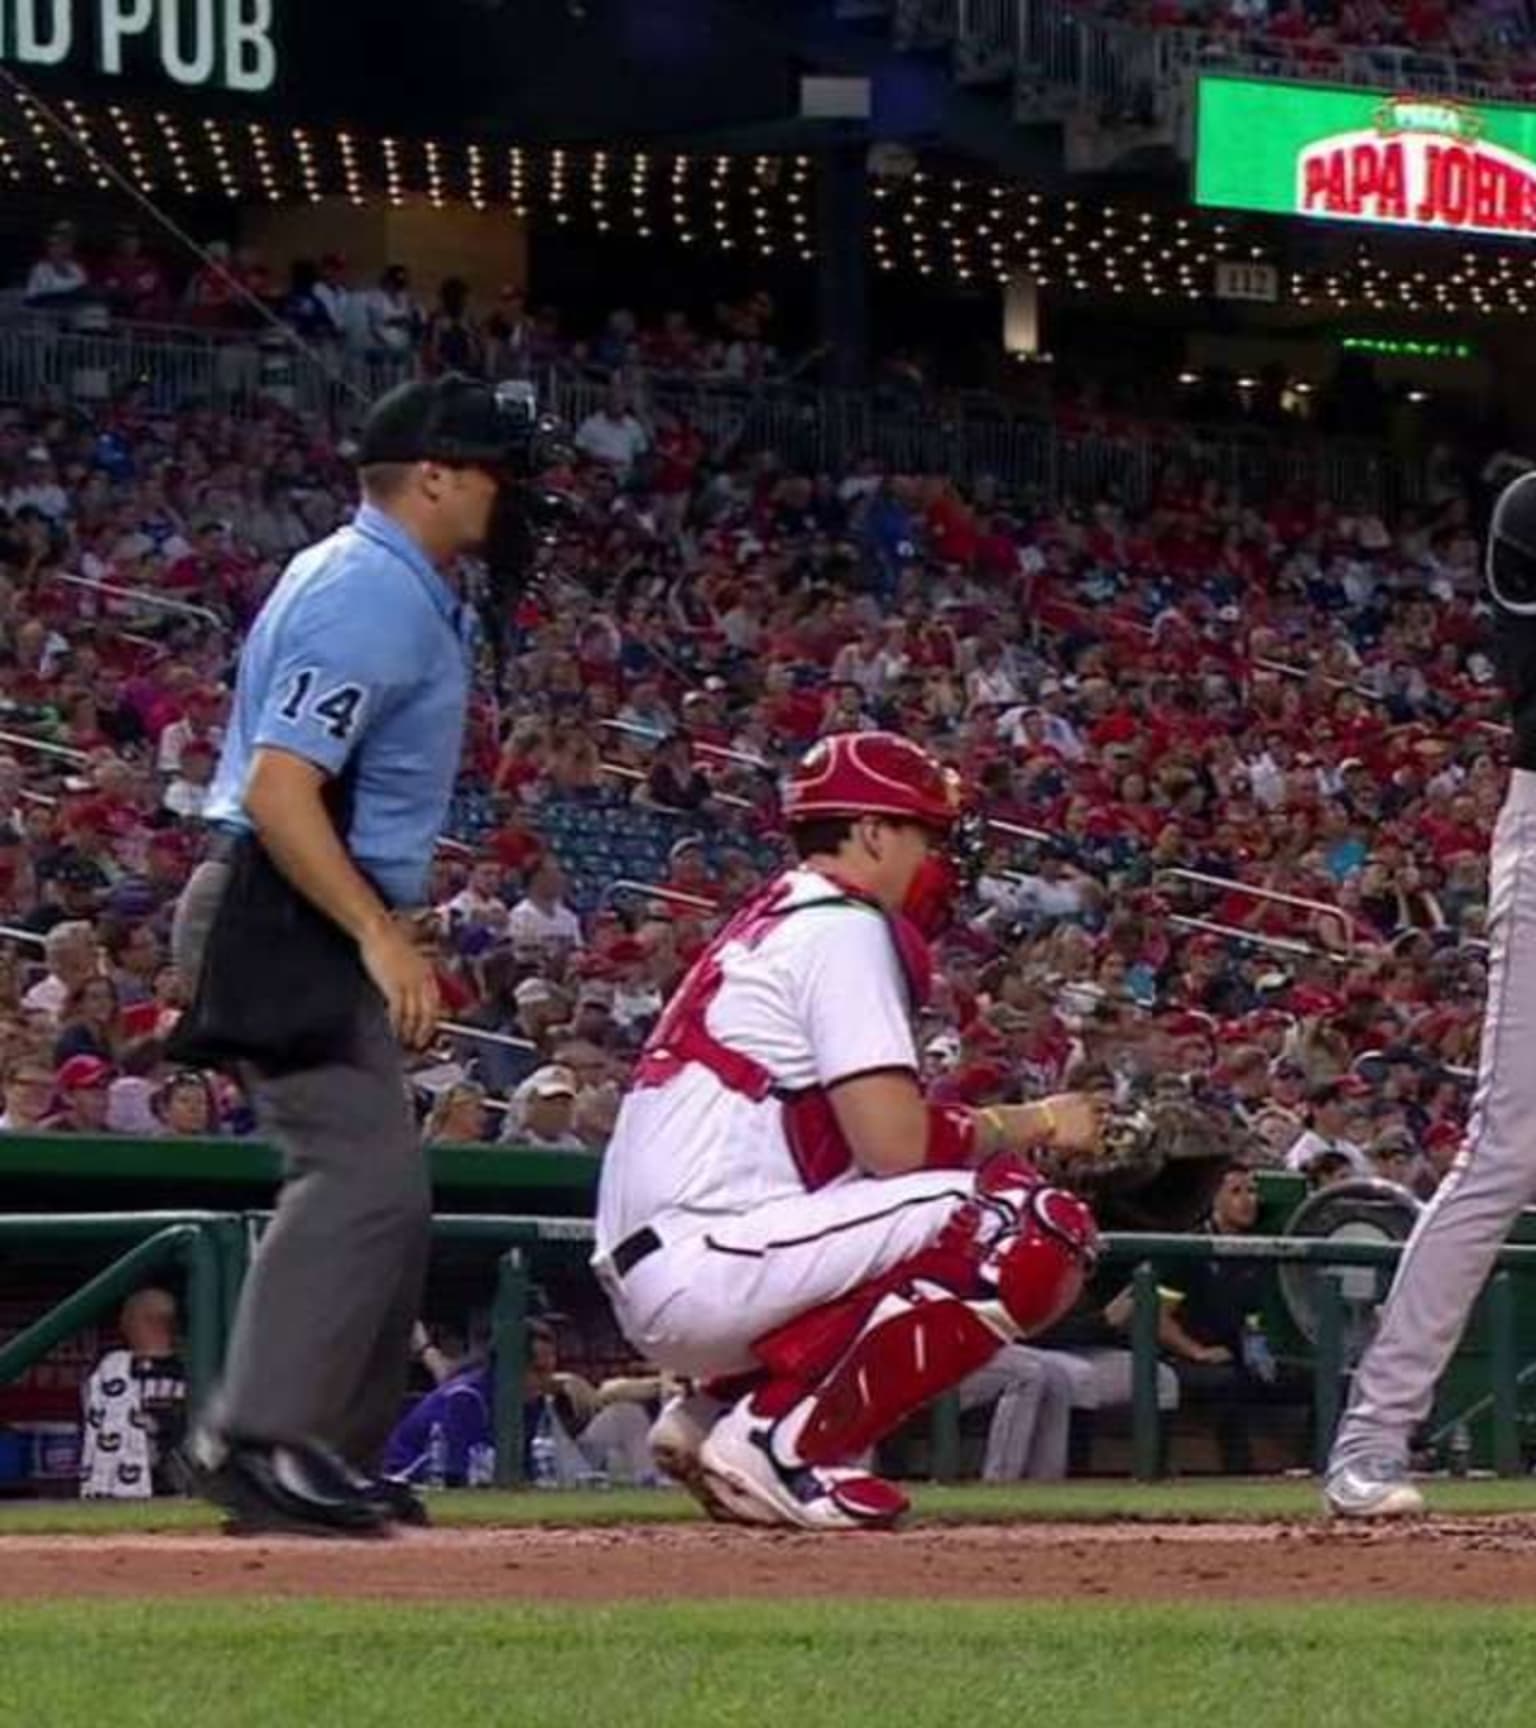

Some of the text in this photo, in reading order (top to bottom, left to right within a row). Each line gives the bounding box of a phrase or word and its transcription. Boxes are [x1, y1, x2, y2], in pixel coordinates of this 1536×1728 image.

[101, 0, 275, 91] PUB
[1304, 143, 1407, 218] PAPA
[279, 668, 364, 740] 14
